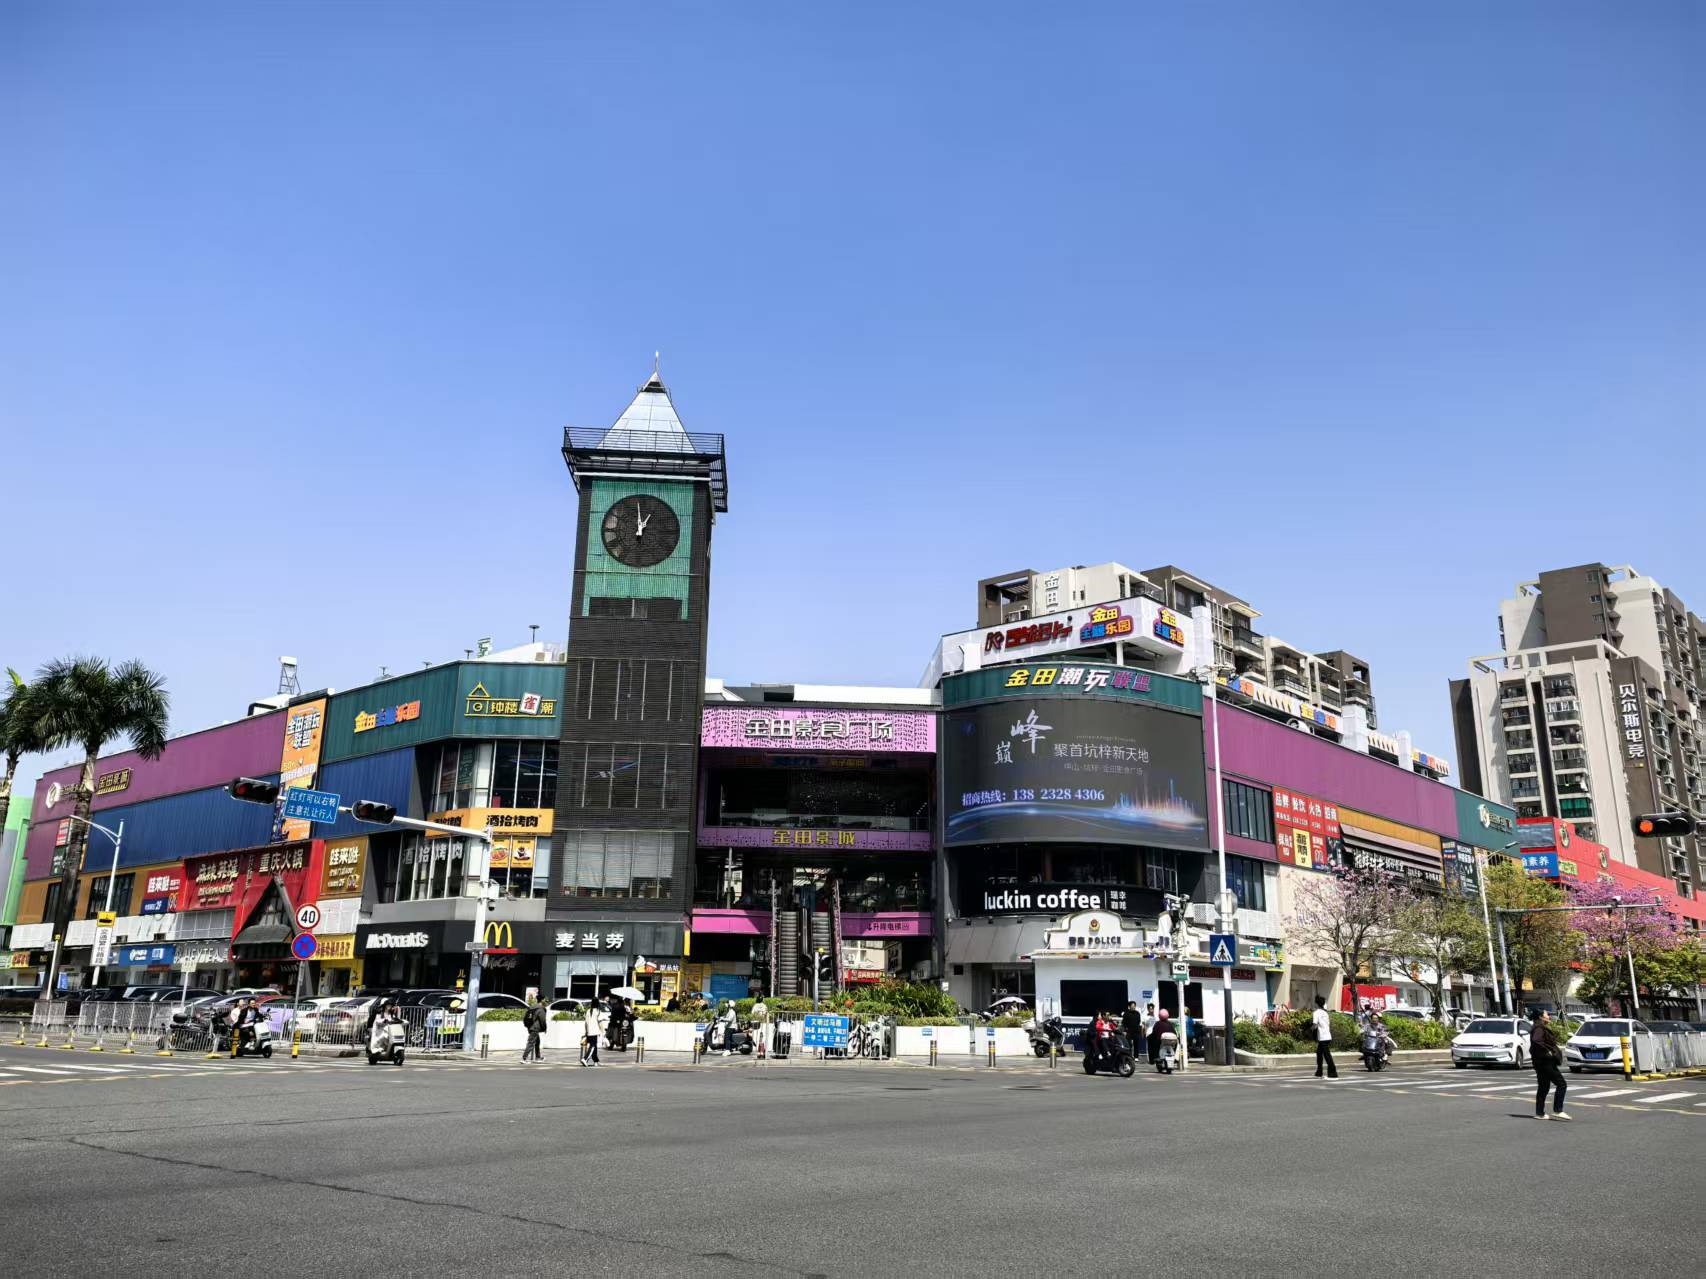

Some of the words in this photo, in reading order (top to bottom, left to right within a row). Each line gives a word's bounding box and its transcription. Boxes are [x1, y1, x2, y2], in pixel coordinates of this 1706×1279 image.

[1092, 607, 1118, 624] 金田
[1004, 667, 1152, 692] 金田潮玩联盟
[1618, 684, 1646, 759] 贝尔斯电竞
[1054, 742, 1149, 764] 聚首坑梓新天地
[288, 791, 336, 808] 红灯可以右转
[1013, 790, 1034, 801] 138
[1041, 789, 1071, 801] 2328
[1075, 789, 1104, 801] 4306
[286, 804, 333, 820] 注意礼让行人
[486, 814, 539, 828] 酒拾烤肉
[773, 829, 855, 847] 金田影城
[258, 848, 304, 873] 重庆火锅
[984, 889, 1031, 910] luckin
[1037, 889, 1101, 909] coffee
[301, 909, 316, 924] 40
[366, 931, 429, 949] McDonald's
[555, 932, 625, 949] 麦当劳
[1088, 936, 1121, 945] POLICE
